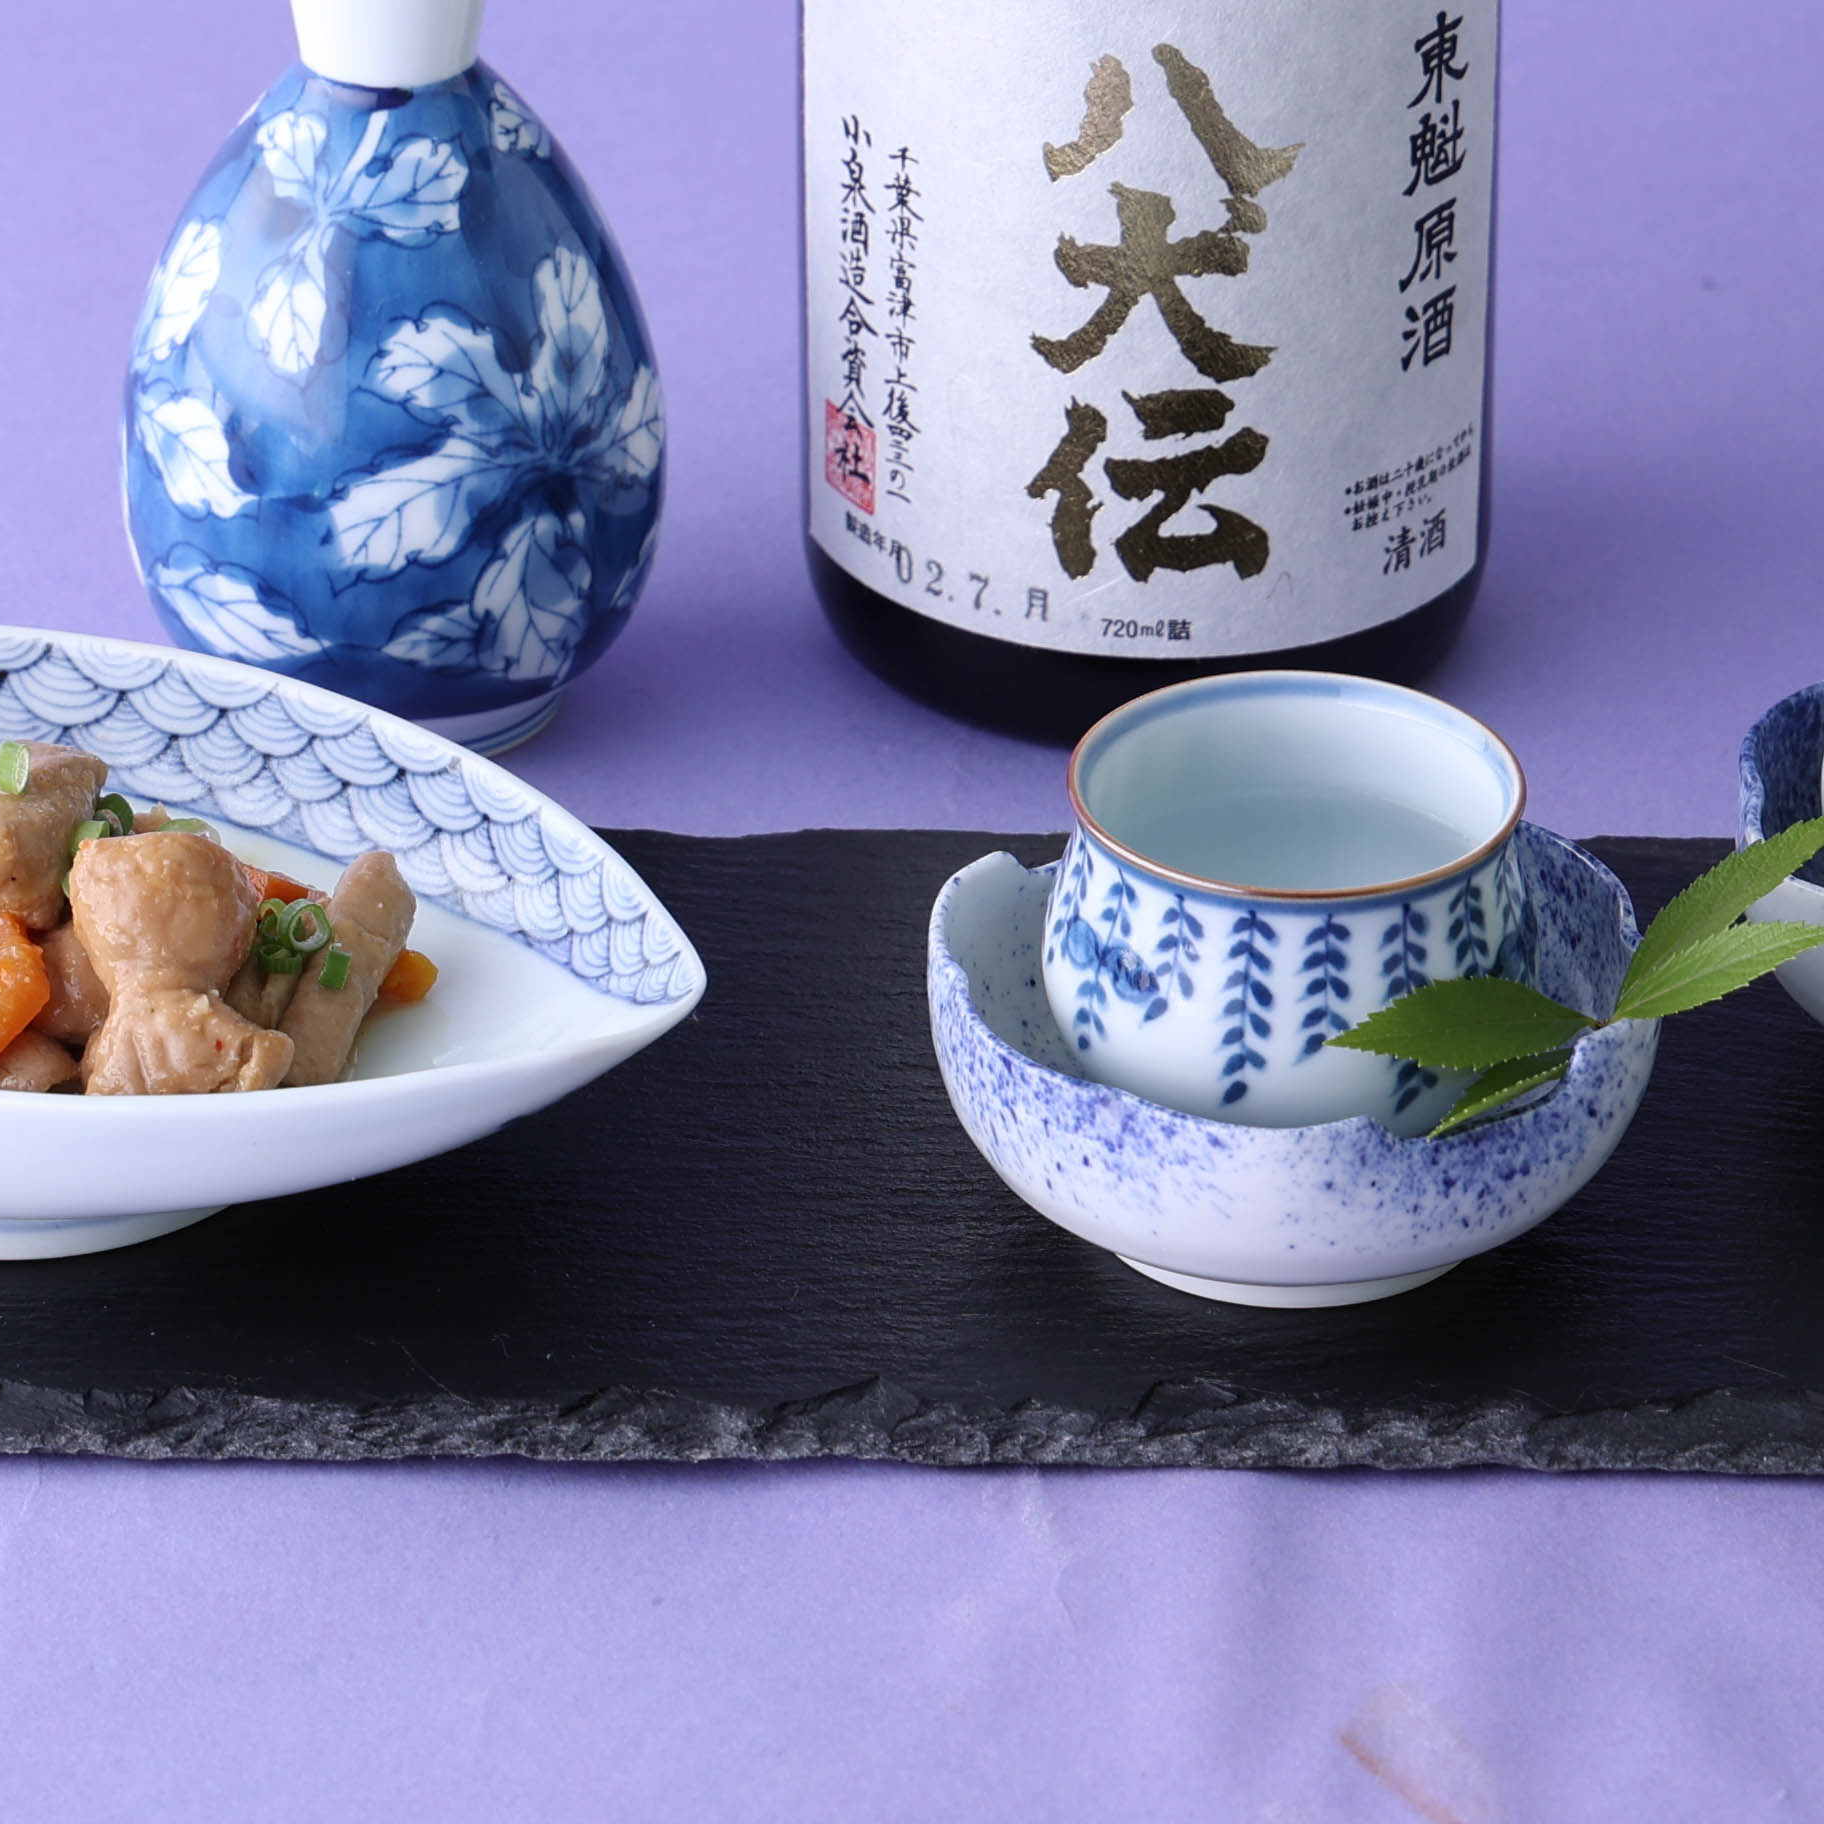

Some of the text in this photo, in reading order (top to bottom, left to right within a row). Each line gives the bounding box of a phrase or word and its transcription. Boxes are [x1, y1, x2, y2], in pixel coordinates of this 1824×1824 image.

[1026, 42, 1307, 584] 八犬伝
[1398, 10, 1469, 372] 東魁原酒
[1382, 506, 1447, 575] 清酒
